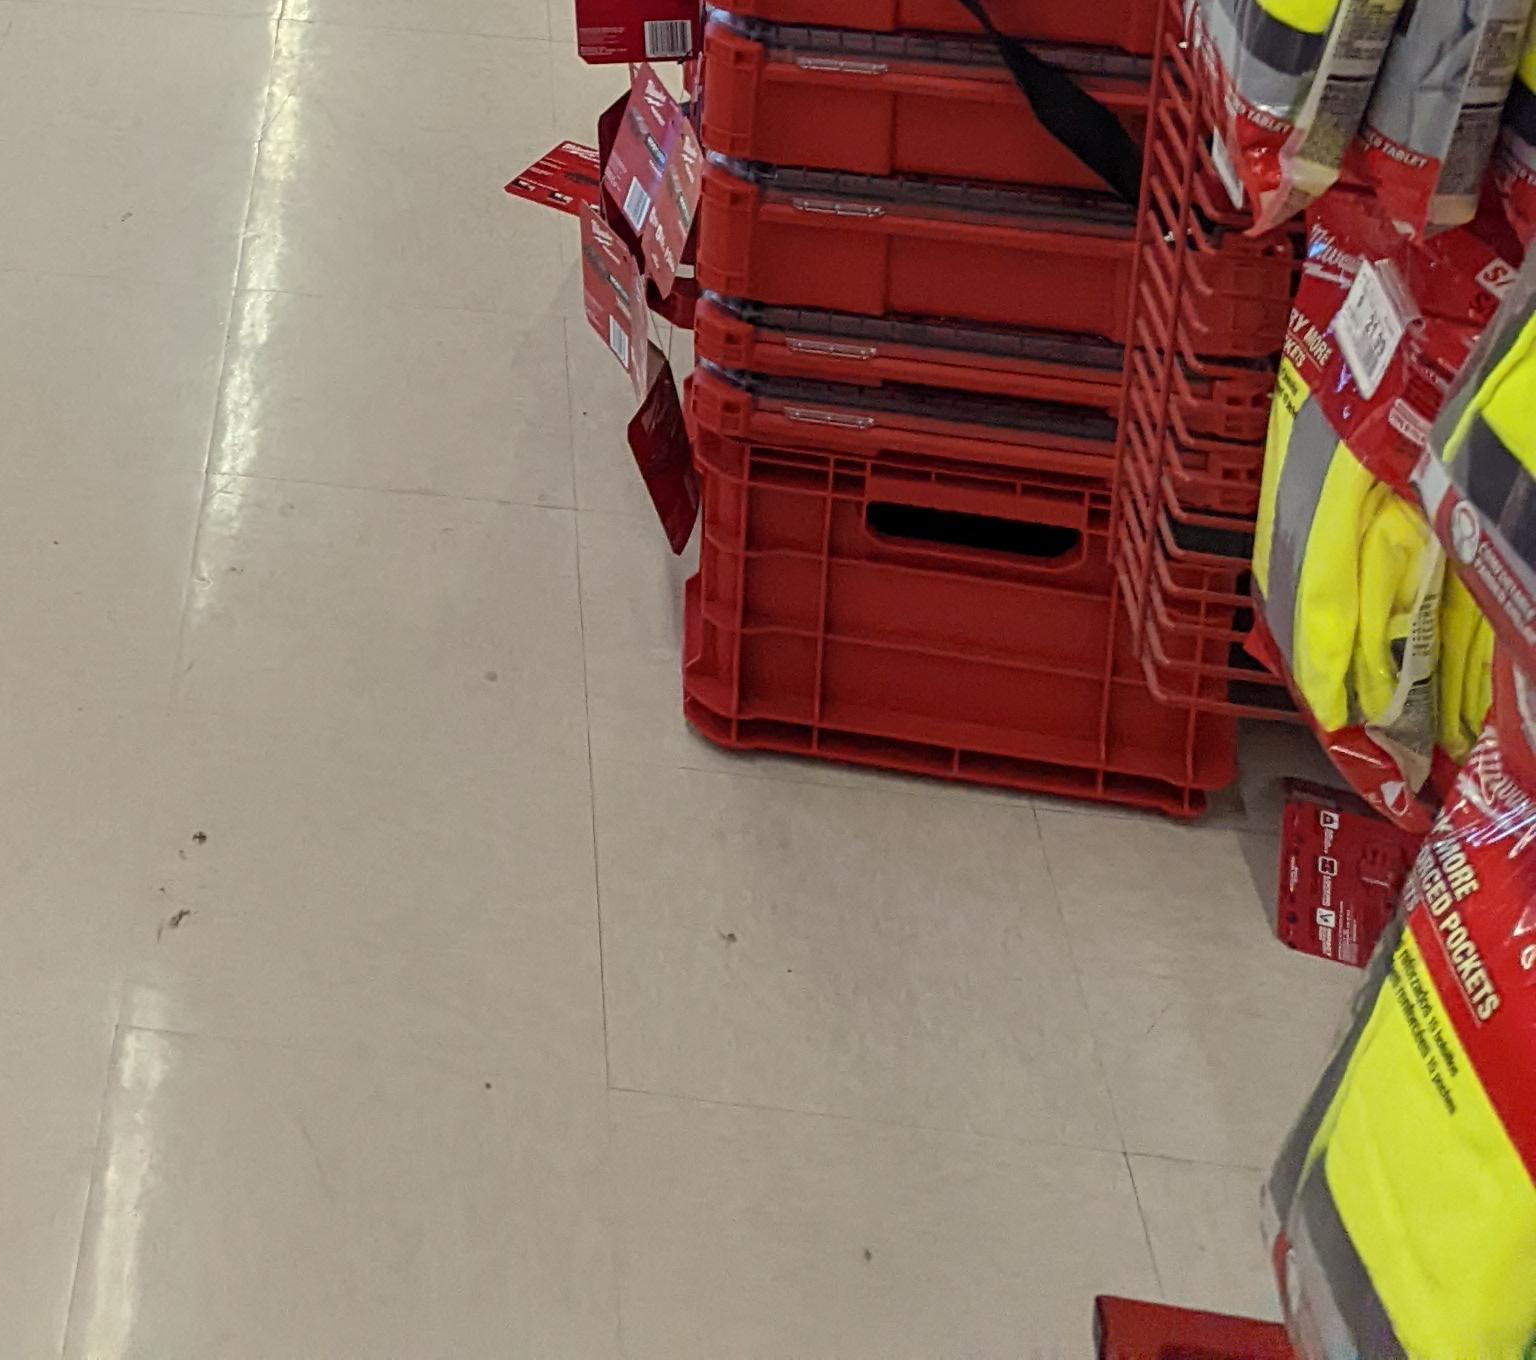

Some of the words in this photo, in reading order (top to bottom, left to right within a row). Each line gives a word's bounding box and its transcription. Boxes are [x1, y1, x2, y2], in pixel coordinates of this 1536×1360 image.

[1304, 327, 1333, 367] MORE
[1434, 836, 1480, 903] MORE
[1438, 909, 1501, 1022] POCKETS
